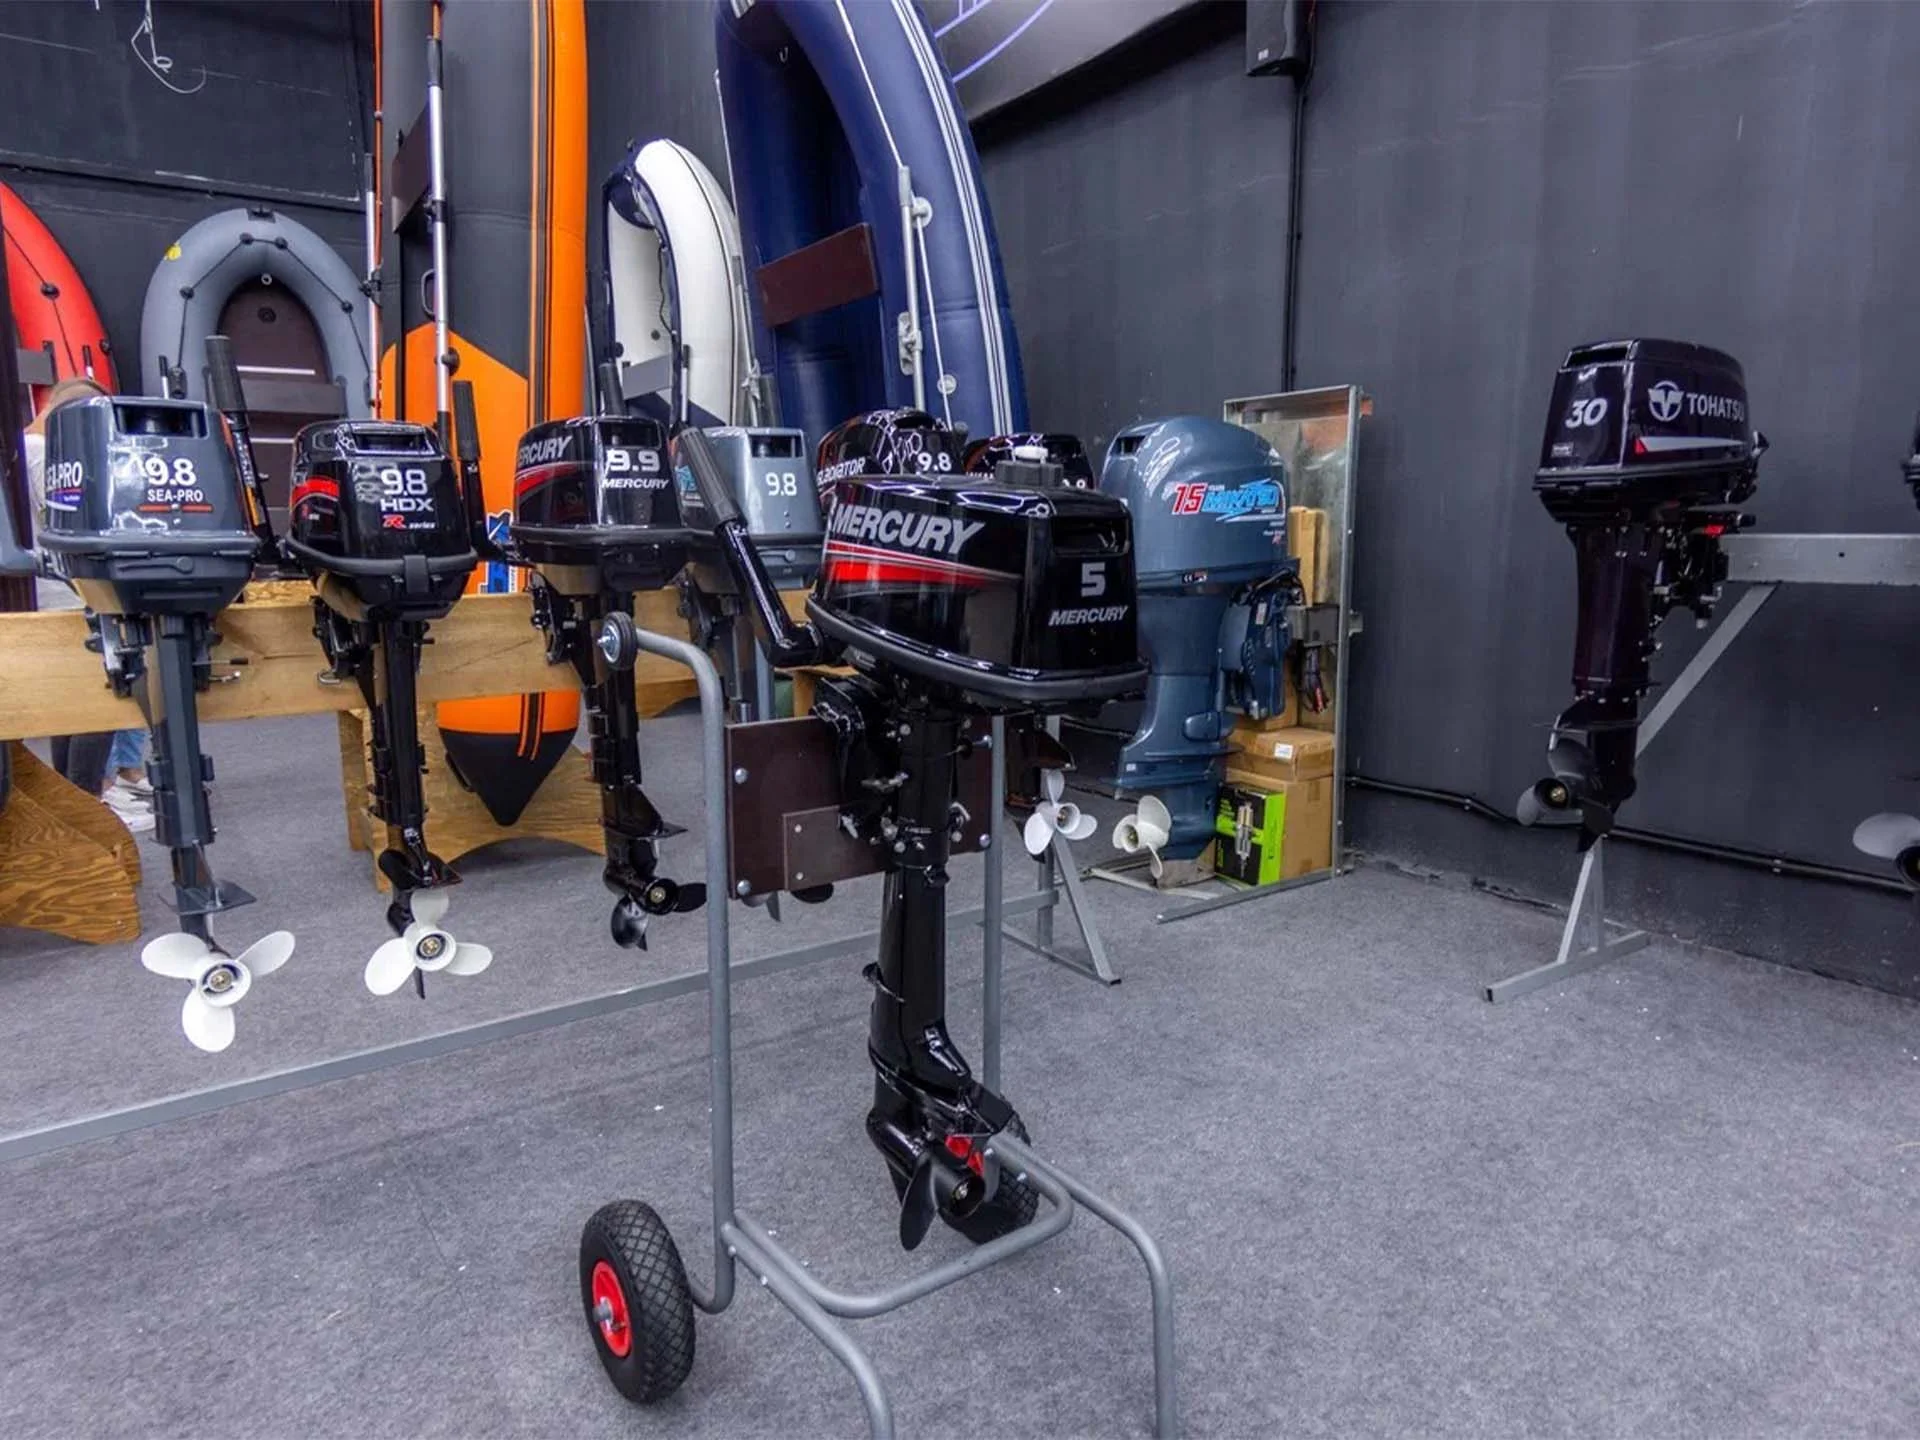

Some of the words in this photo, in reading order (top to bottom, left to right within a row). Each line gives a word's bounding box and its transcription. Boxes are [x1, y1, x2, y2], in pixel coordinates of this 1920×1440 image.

[1565, 398, 1608, 429] 30
[1686, 393, 1746, 422] TOHATSU
[145, 457, 197, 486] 9.8
[917, 452, 952, 471] 9.8
[147, 489, 204, 502] SEA-PRO
[381, 469, 428, 496] 9.8
[602, 478, 669, 489] MERCURY
[765, 472, 797, 497] 9.8
[380, 498, 434, 512] HDX
[1171, 482, 1208, 515] 15
[830, 503, 985, 555] MERCURY
[1081, 562, 1106, 597] 5
[1049, 605, 1128, 627] MERCURY
